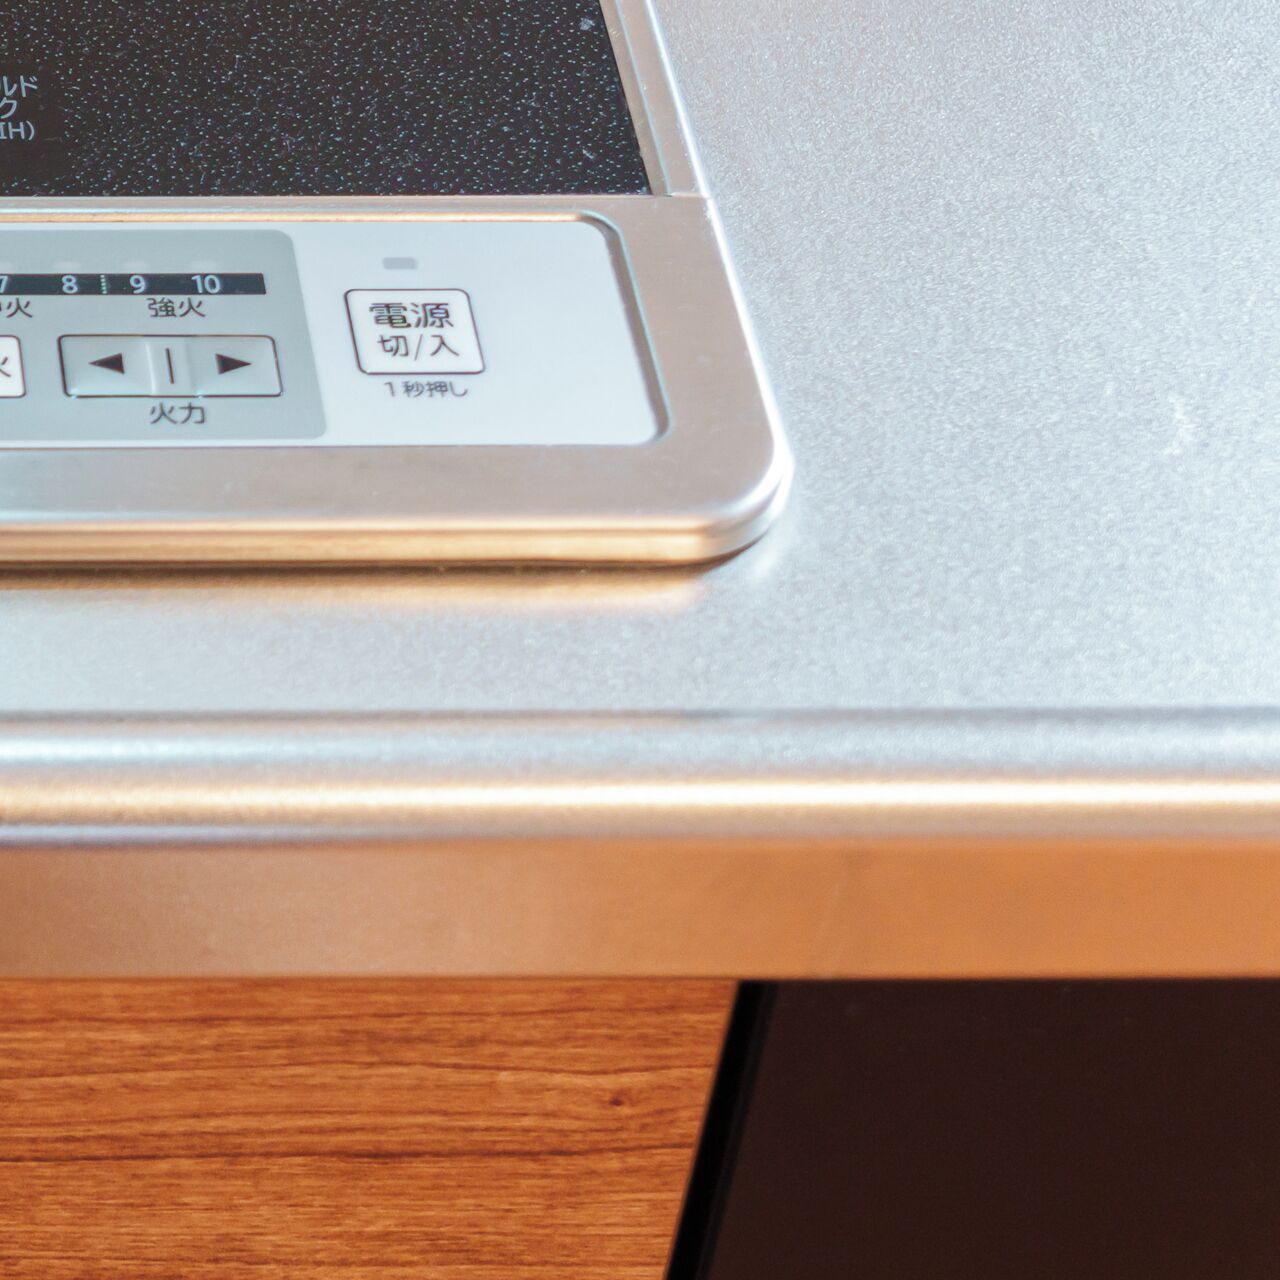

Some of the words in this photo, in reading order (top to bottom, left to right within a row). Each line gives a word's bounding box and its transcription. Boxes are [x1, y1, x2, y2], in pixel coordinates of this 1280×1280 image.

[61, 275, 78, 294] 8
[129, 275, 147, 294] 9
[191, 275, 222, 294] 10
[146, 297, 206, 318] 強火
[369, 302, 454, 329] 電源
[377, 334, 460, 361] 切/入
[150, 401, 206, 425] 火力
